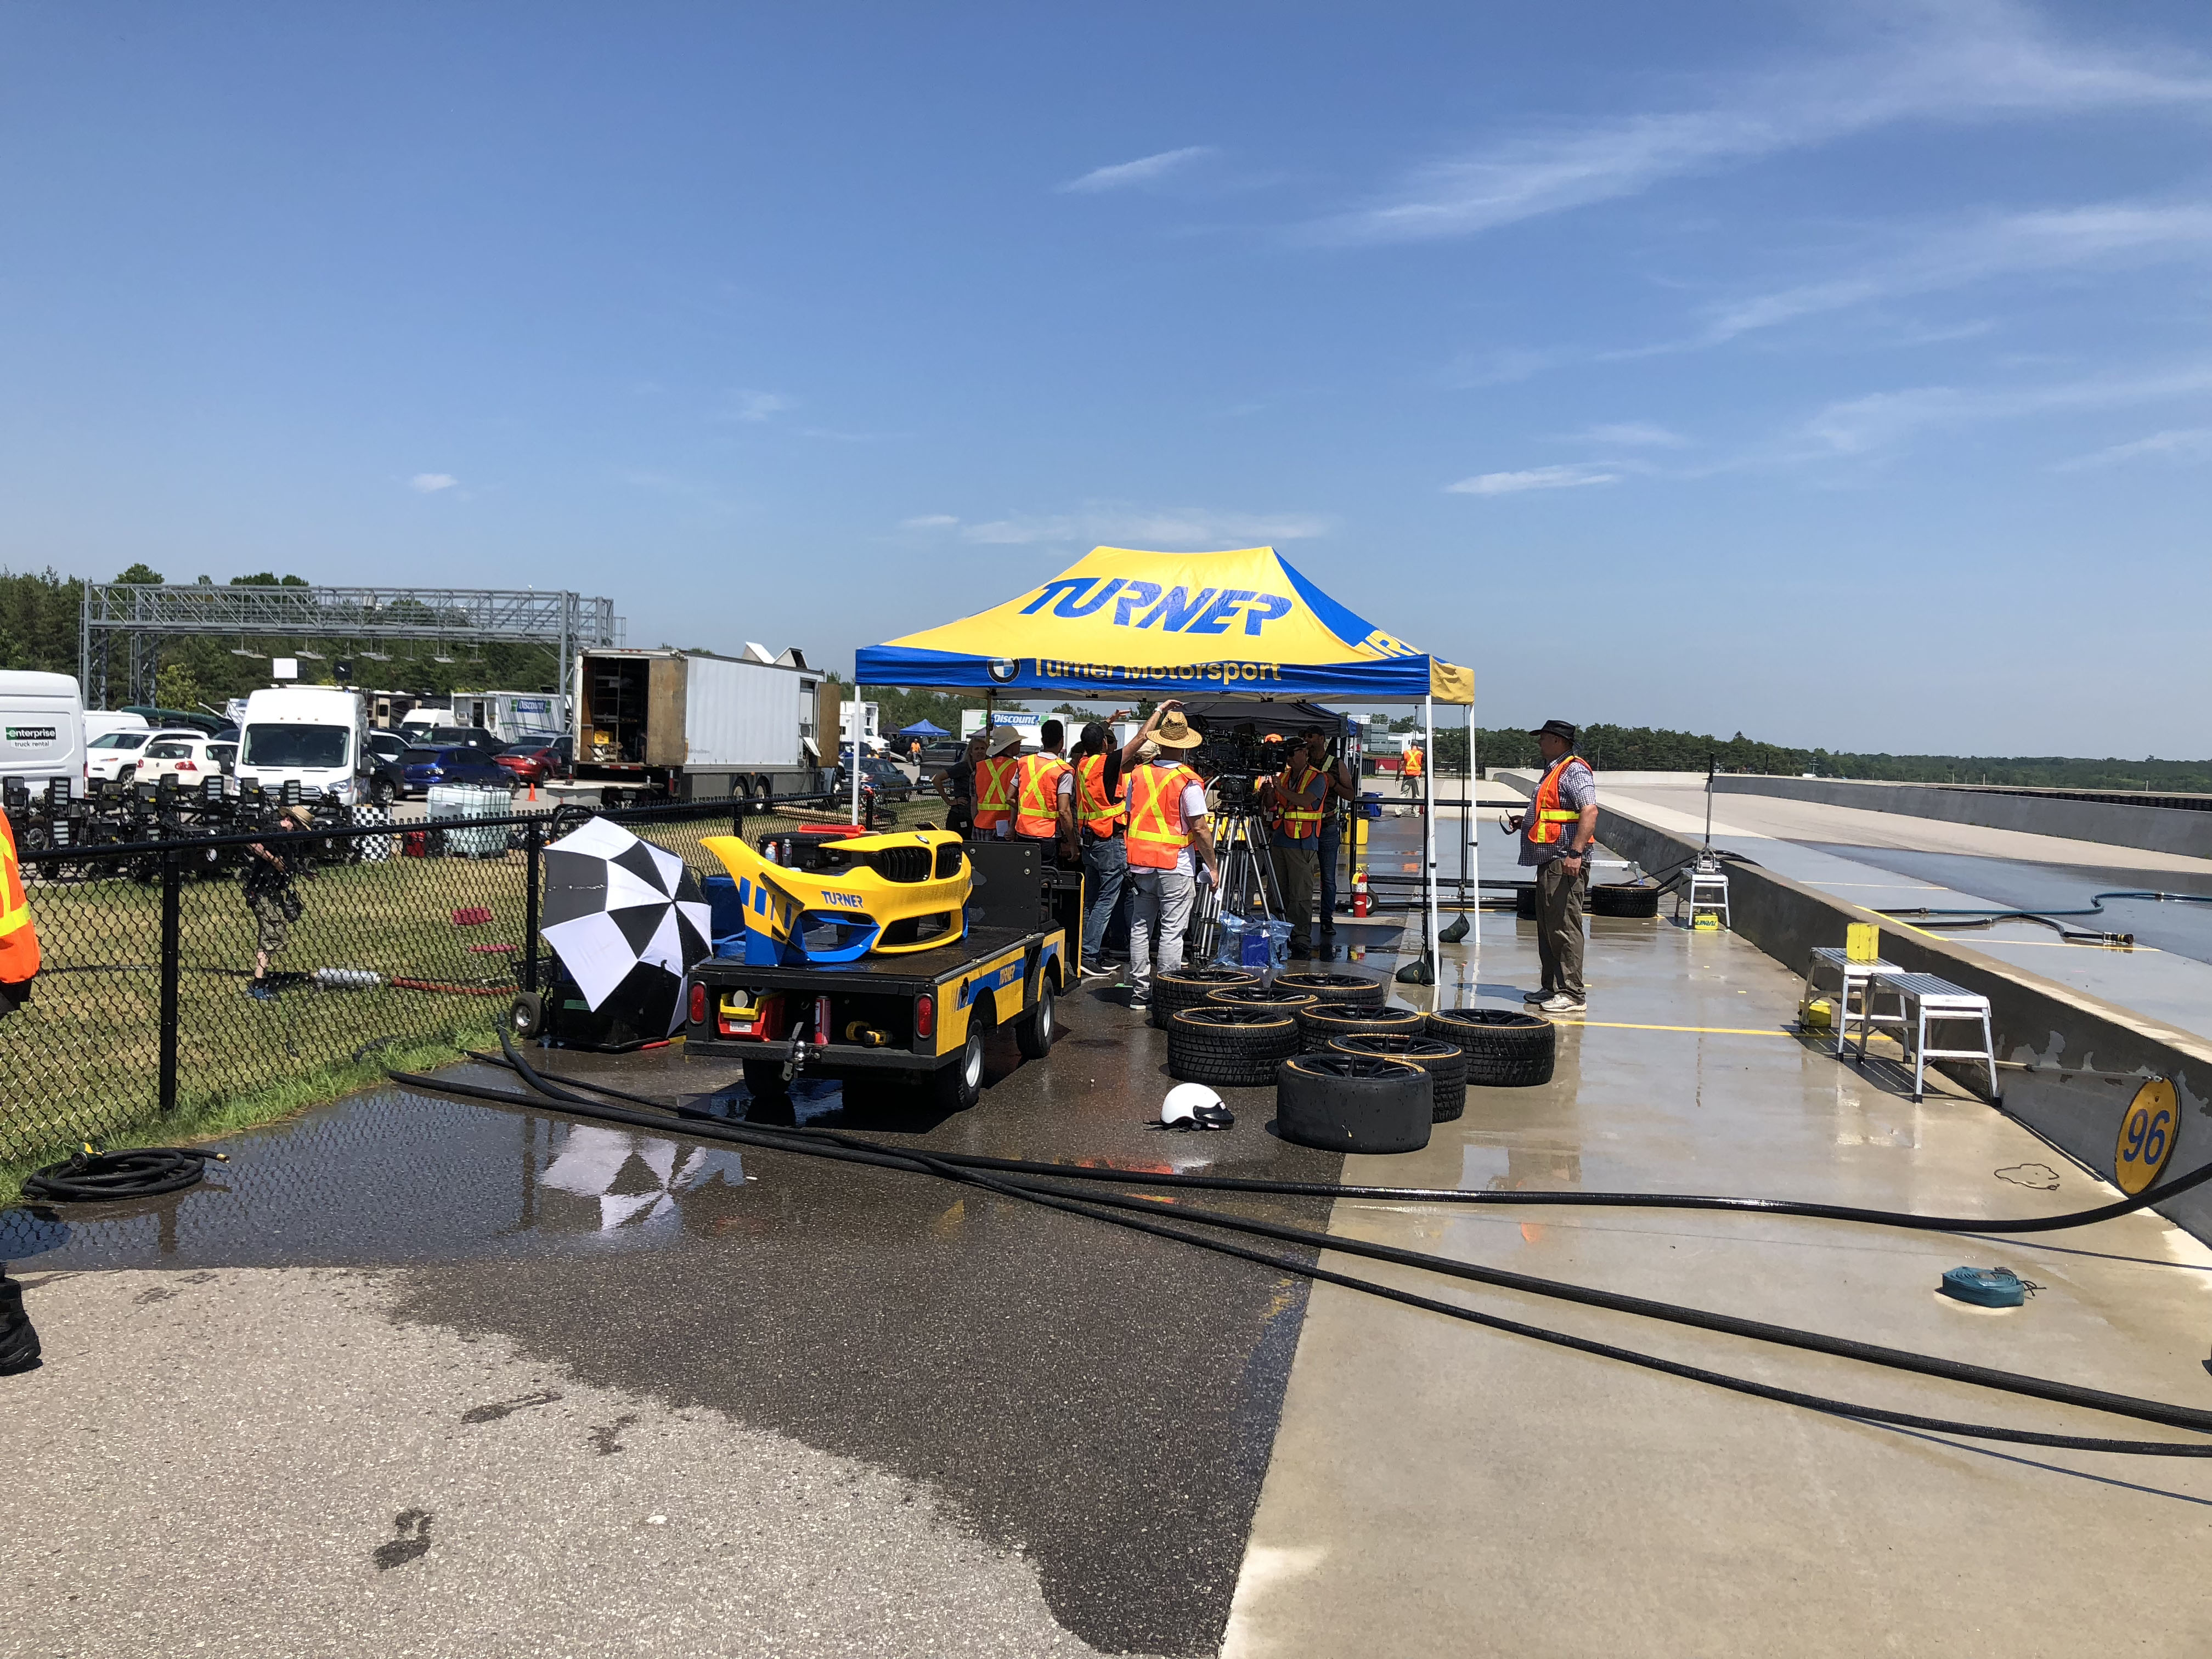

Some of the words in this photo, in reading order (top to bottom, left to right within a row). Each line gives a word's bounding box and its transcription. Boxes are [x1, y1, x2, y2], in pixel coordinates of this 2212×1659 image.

[1018, 578, 1293, 636] TURNER
[1124, 662, 1281, 685] Motorsport
[994, 714, 1036, 724] Discount
[8, 728, 55, 739] enterprise
[821, 890, 864, 909] TURNER
[2123, 1108, 2170, 1165] 96
